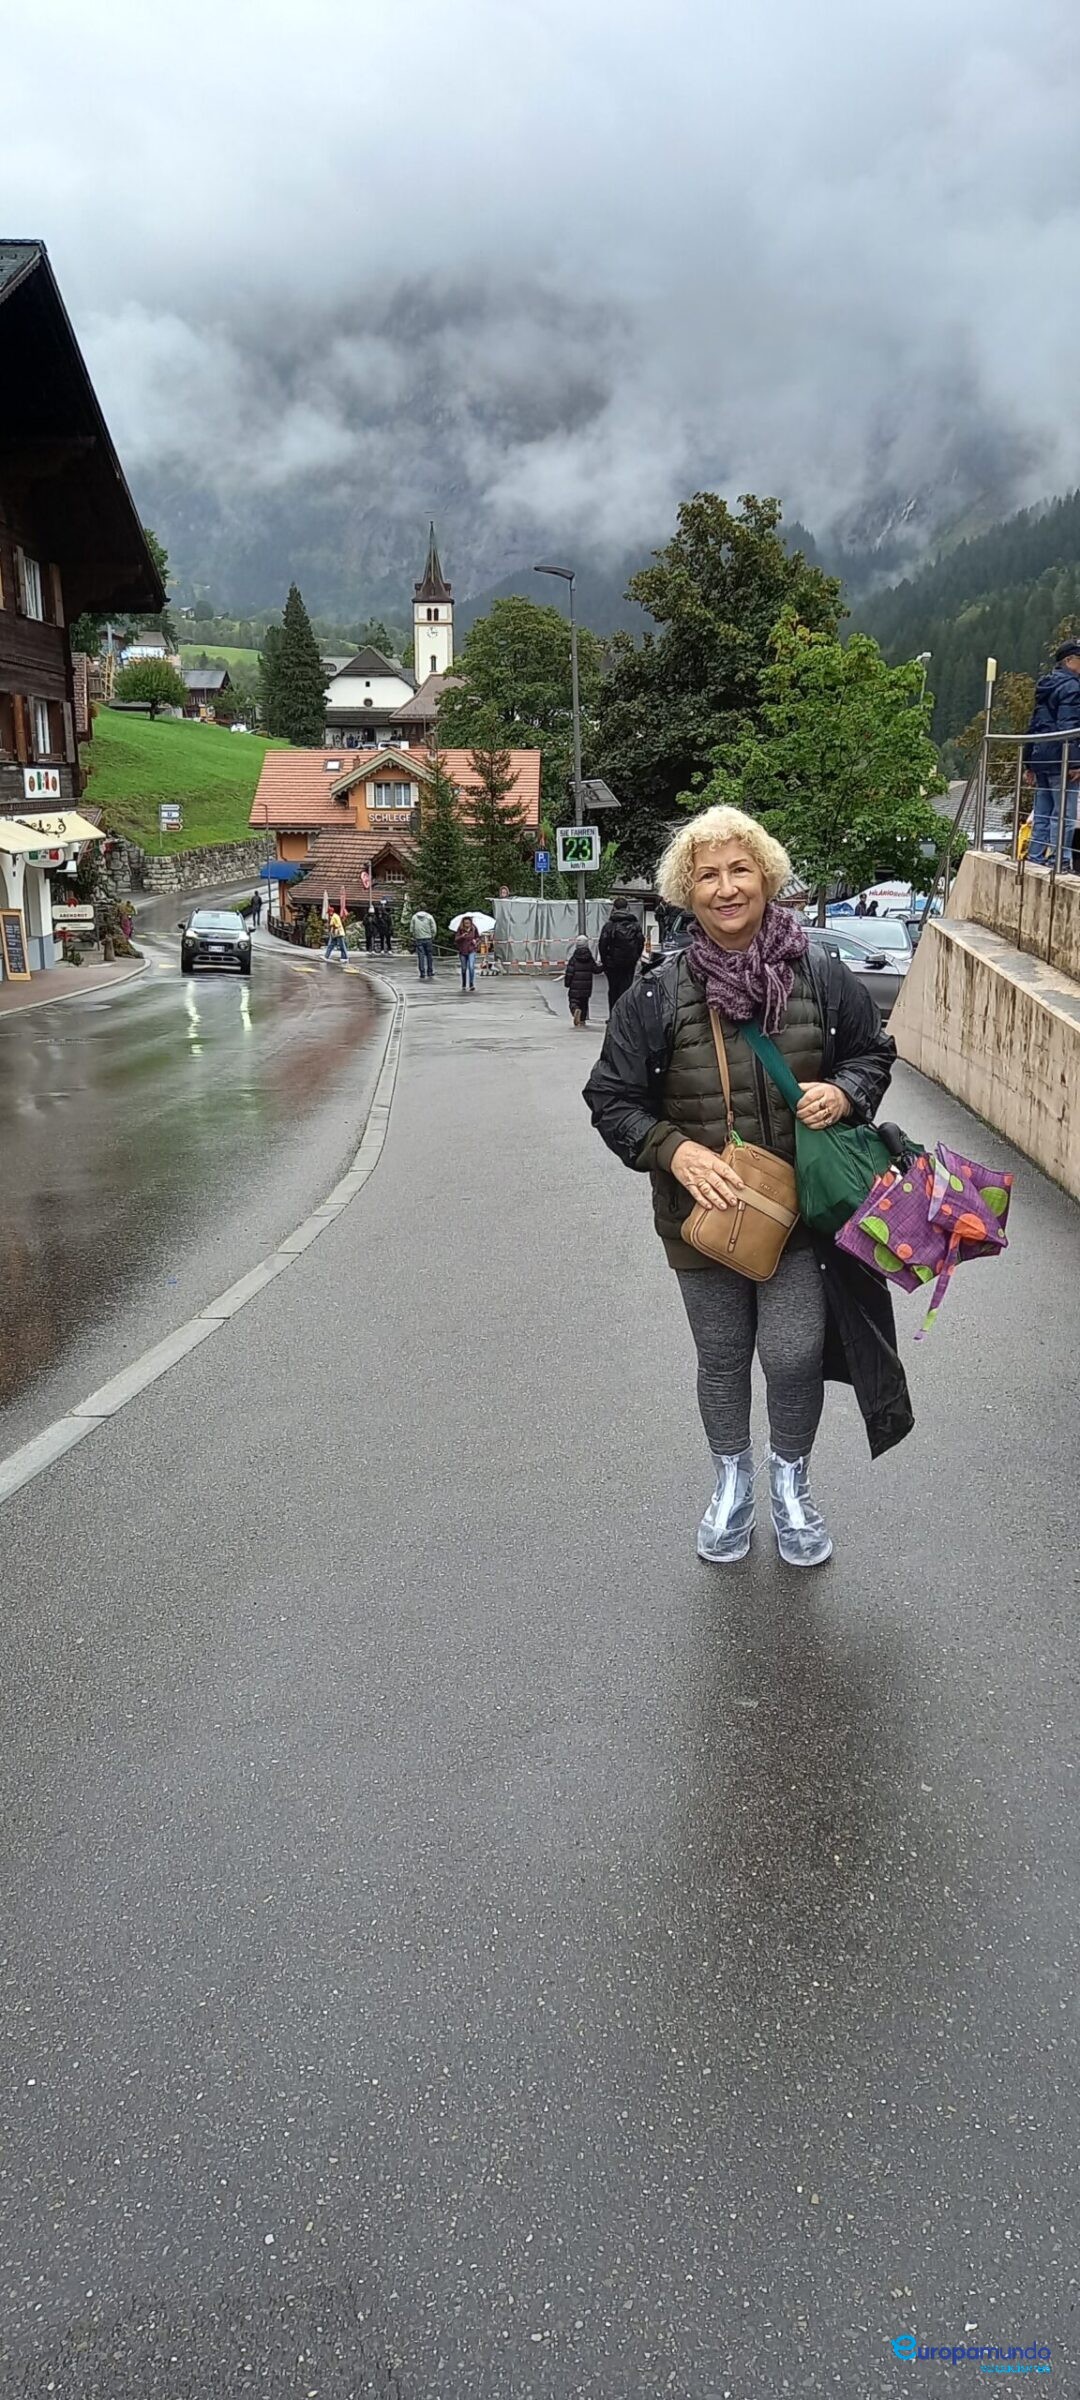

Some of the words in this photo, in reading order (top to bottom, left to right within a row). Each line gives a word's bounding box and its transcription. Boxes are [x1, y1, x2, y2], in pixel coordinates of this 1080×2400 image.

[560, 829, 570, 837] SIE
[571, 828, 595, 836] FAHREN
[565, 837, 591, 861] 23
